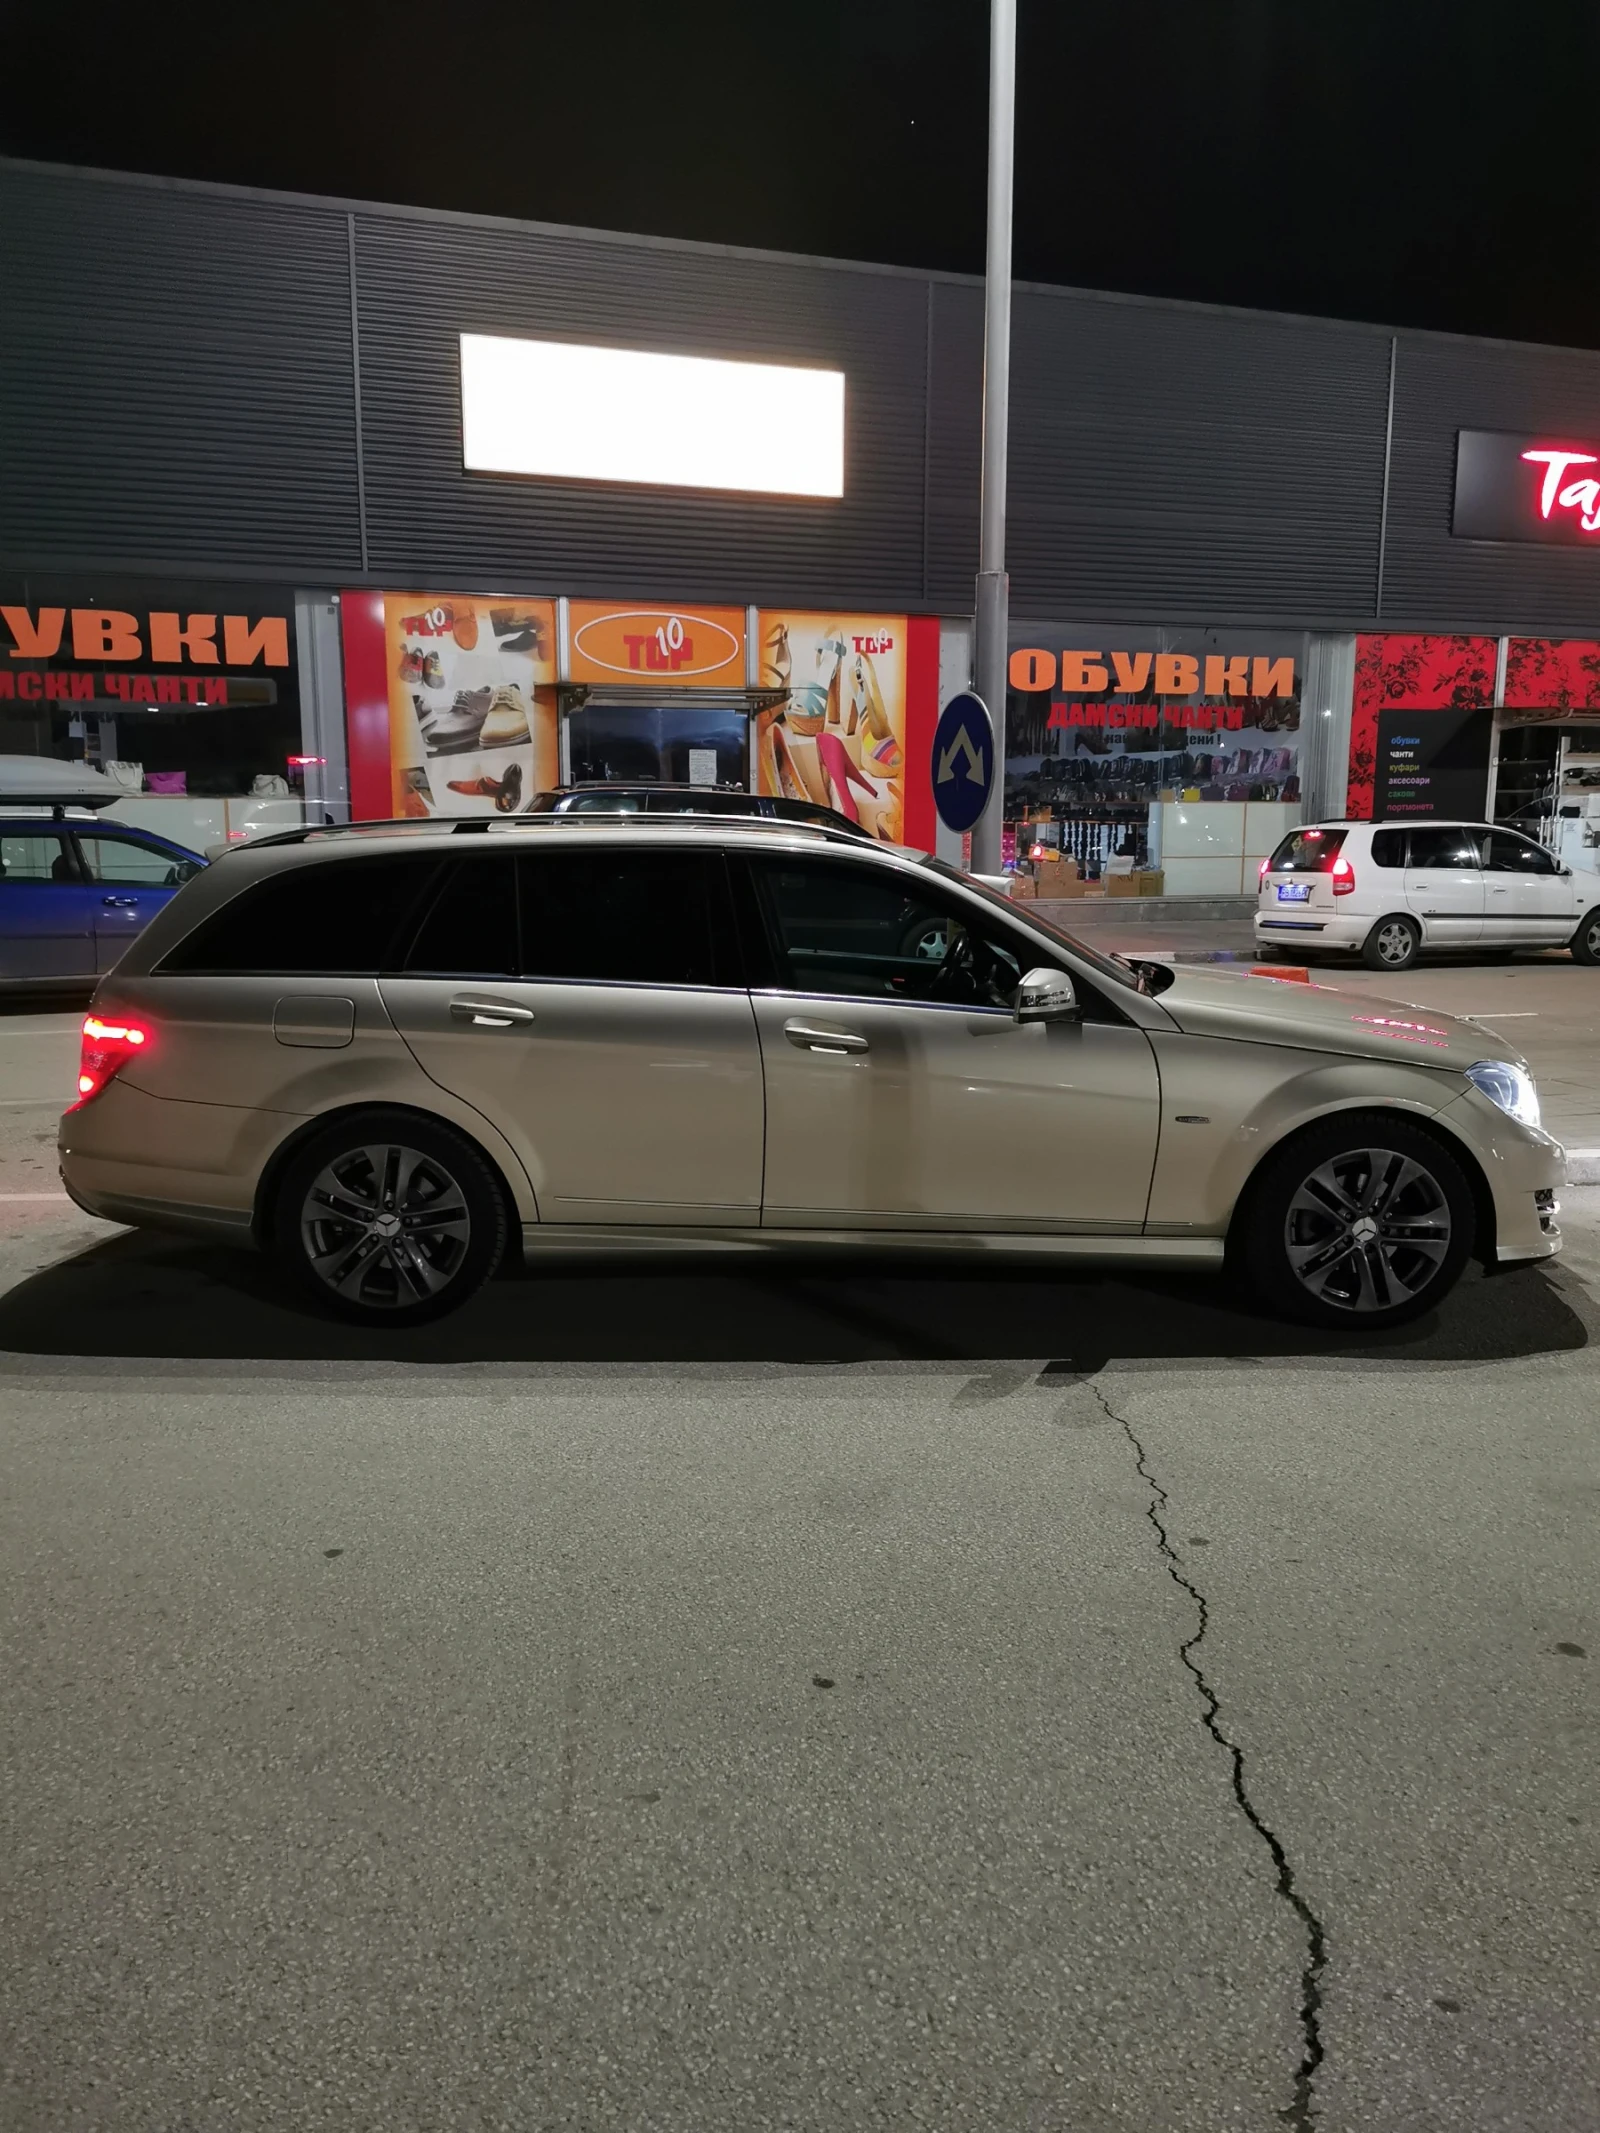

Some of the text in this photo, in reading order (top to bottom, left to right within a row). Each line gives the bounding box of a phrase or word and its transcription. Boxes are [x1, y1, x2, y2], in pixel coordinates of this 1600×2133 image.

[425, 607, 445, 631] 10
[0, 605, 289, 667] УВКИ
[655, 617, 684, 656] 10
[1009, 648, 1295, 697] ОБУВКИ
[104, 673, 229, 705] ЧАНТИ
[1047, 702, 1243, 729] ДАМСКИ ЧАНТИ
[1391, 736, 1420, 746] обувки
[1388, 777, 1430, 785] аксесоари
[1389, 763, 1420, 772] куфари
